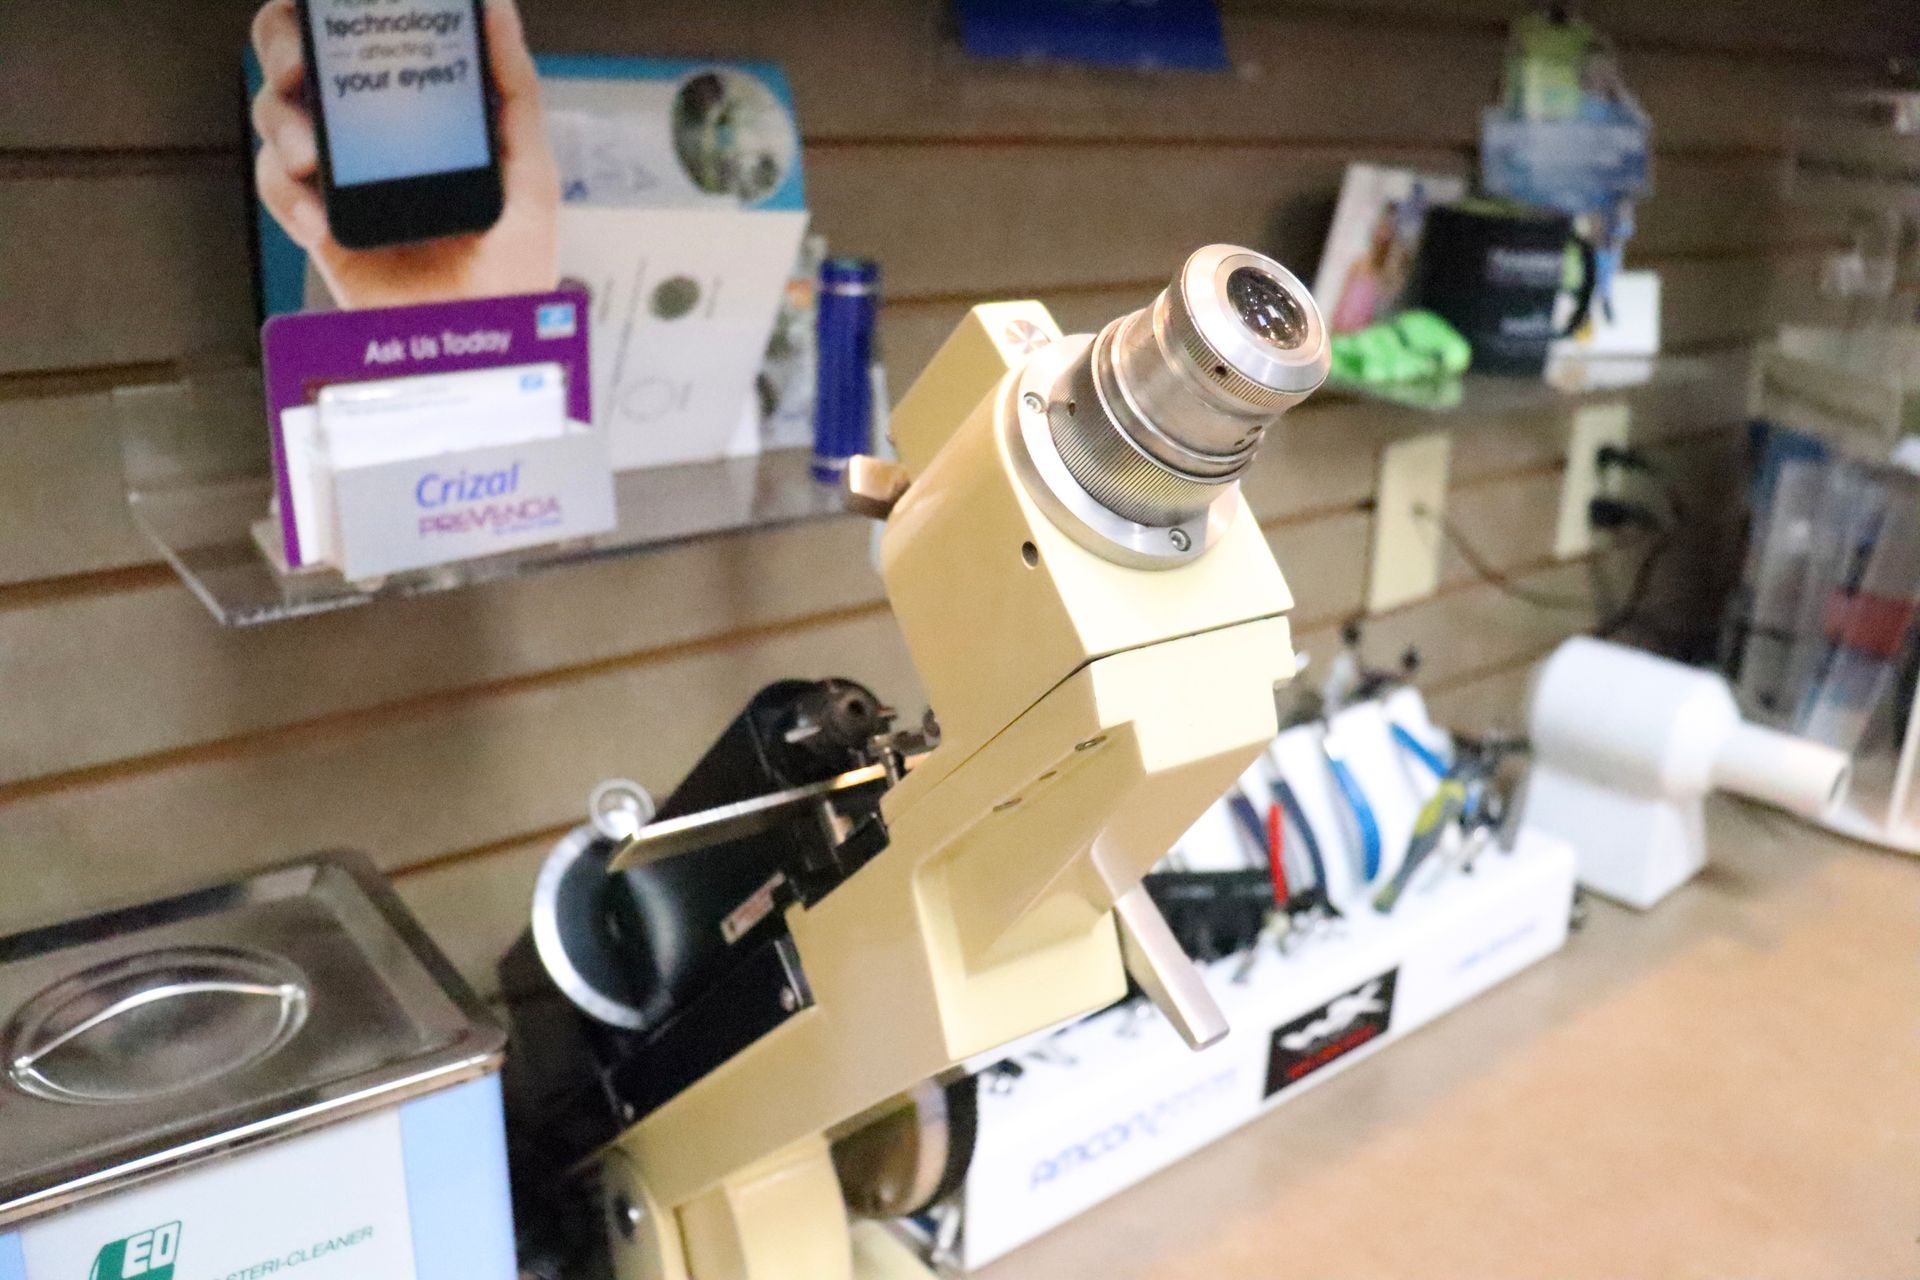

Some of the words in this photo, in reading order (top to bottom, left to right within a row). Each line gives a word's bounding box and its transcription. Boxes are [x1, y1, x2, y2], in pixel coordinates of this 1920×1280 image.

[324, 10, 464, 38] technology
[334, 70, 390, 98] your
[398, 56, 468, 92] eyes?
[364, 335, 406, 366] Ask
[409, 334, 440, 361] Us
[442, 328, 514, 357] Today
[415, 461, 522, 509] Crizal
